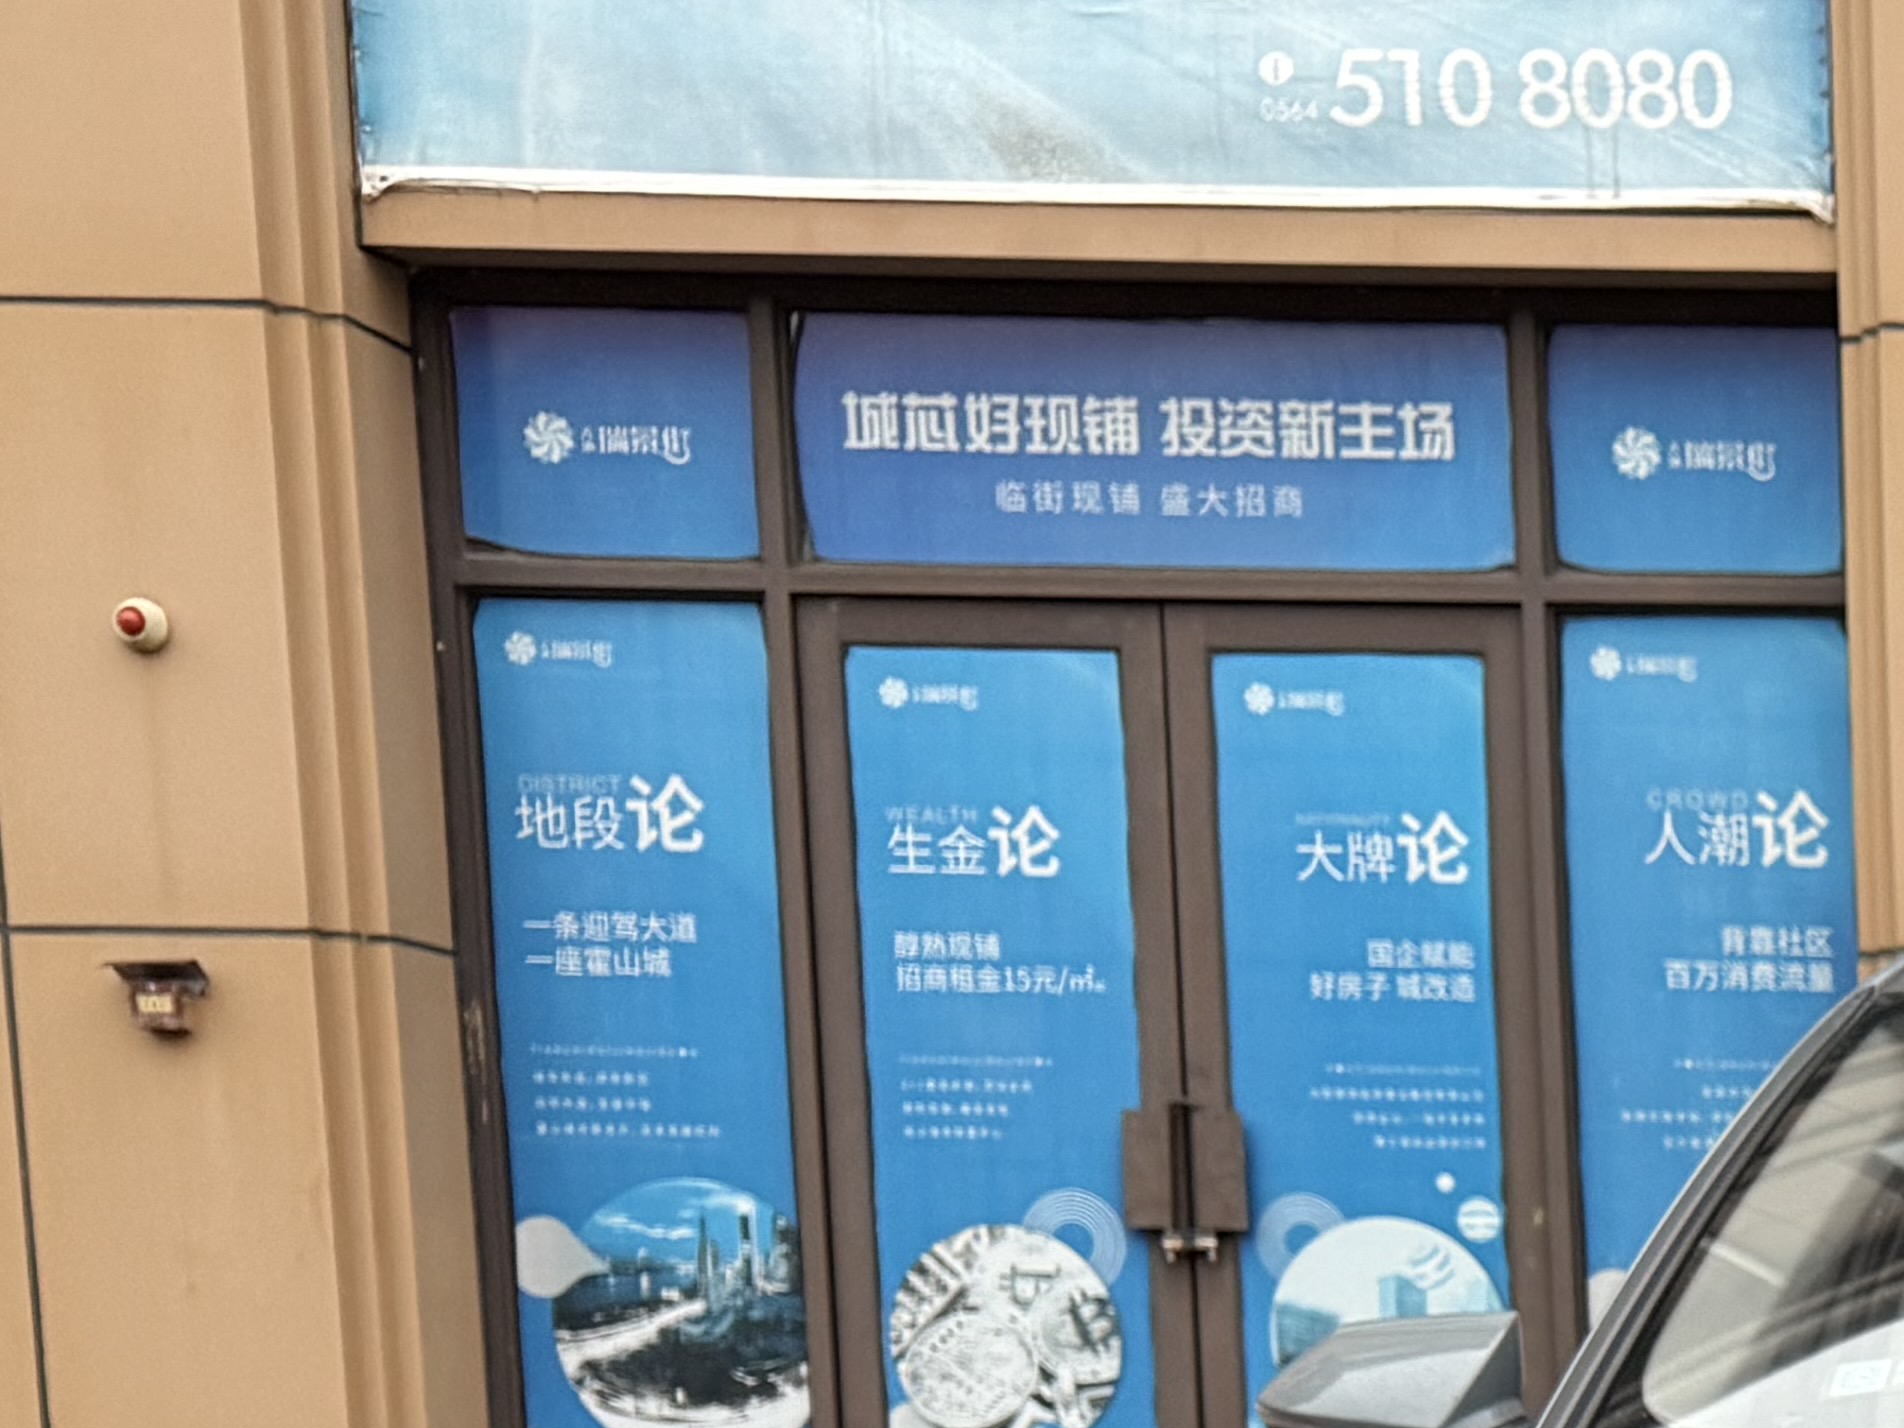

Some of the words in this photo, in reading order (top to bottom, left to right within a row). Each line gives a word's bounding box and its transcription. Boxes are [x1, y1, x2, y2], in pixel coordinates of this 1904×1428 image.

[1330, 48, 1491, 128] 510
[1518, 48, 1731, 130] 8080
[842, 391, 1140, 457] 城芯好现铺
[1159, 398, 1455, 462] 投资新主场
[995, 480, 1140, 515] 临街现铺
[1160, 482, 1303, 518] 盛大招商
[515, 773, 704, 852] 地段论
[887, 804, 1061, 878] 生金论
[1296, 810, 1470, 885] 大牌论
[1645, 789, 1829, 868] 人潮论
